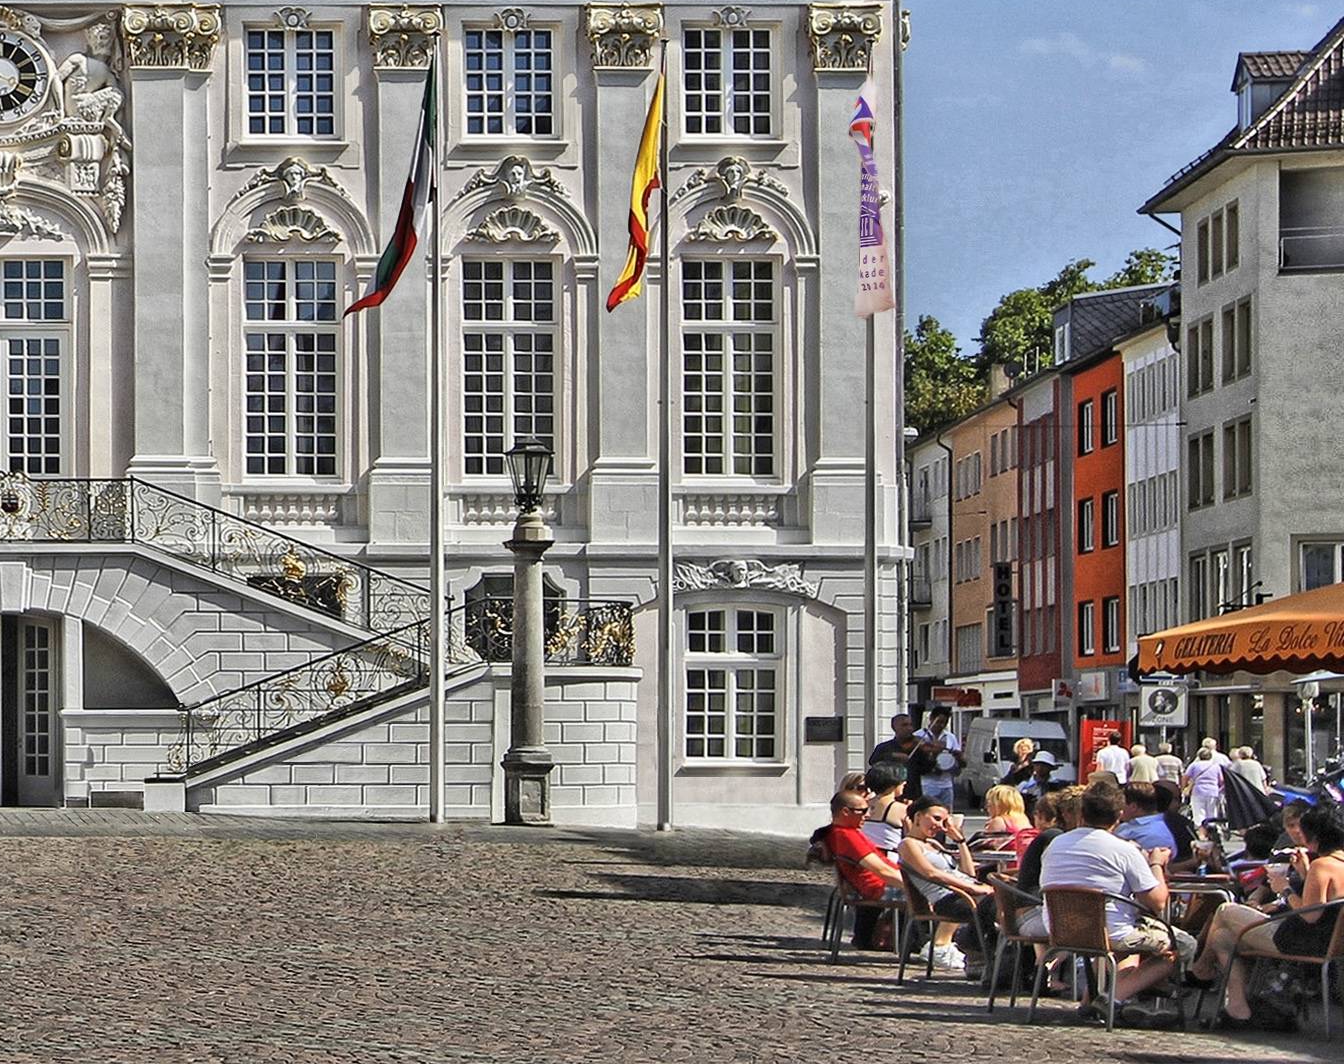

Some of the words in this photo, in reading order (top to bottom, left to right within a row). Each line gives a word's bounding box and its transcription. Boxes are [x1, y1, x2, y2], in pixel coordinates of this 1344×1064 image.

[17, 38, 25, 46] 5
[30, 50, 42, 62] 10
[862, 255, 885, 265] der
[997, 565, 1010, 648] HOTEL
[1174, 633, 1237, 660] GELATERIA
[1248, 626, 1272, 653] La
[1276, 623, 1318, 650] Dolce
